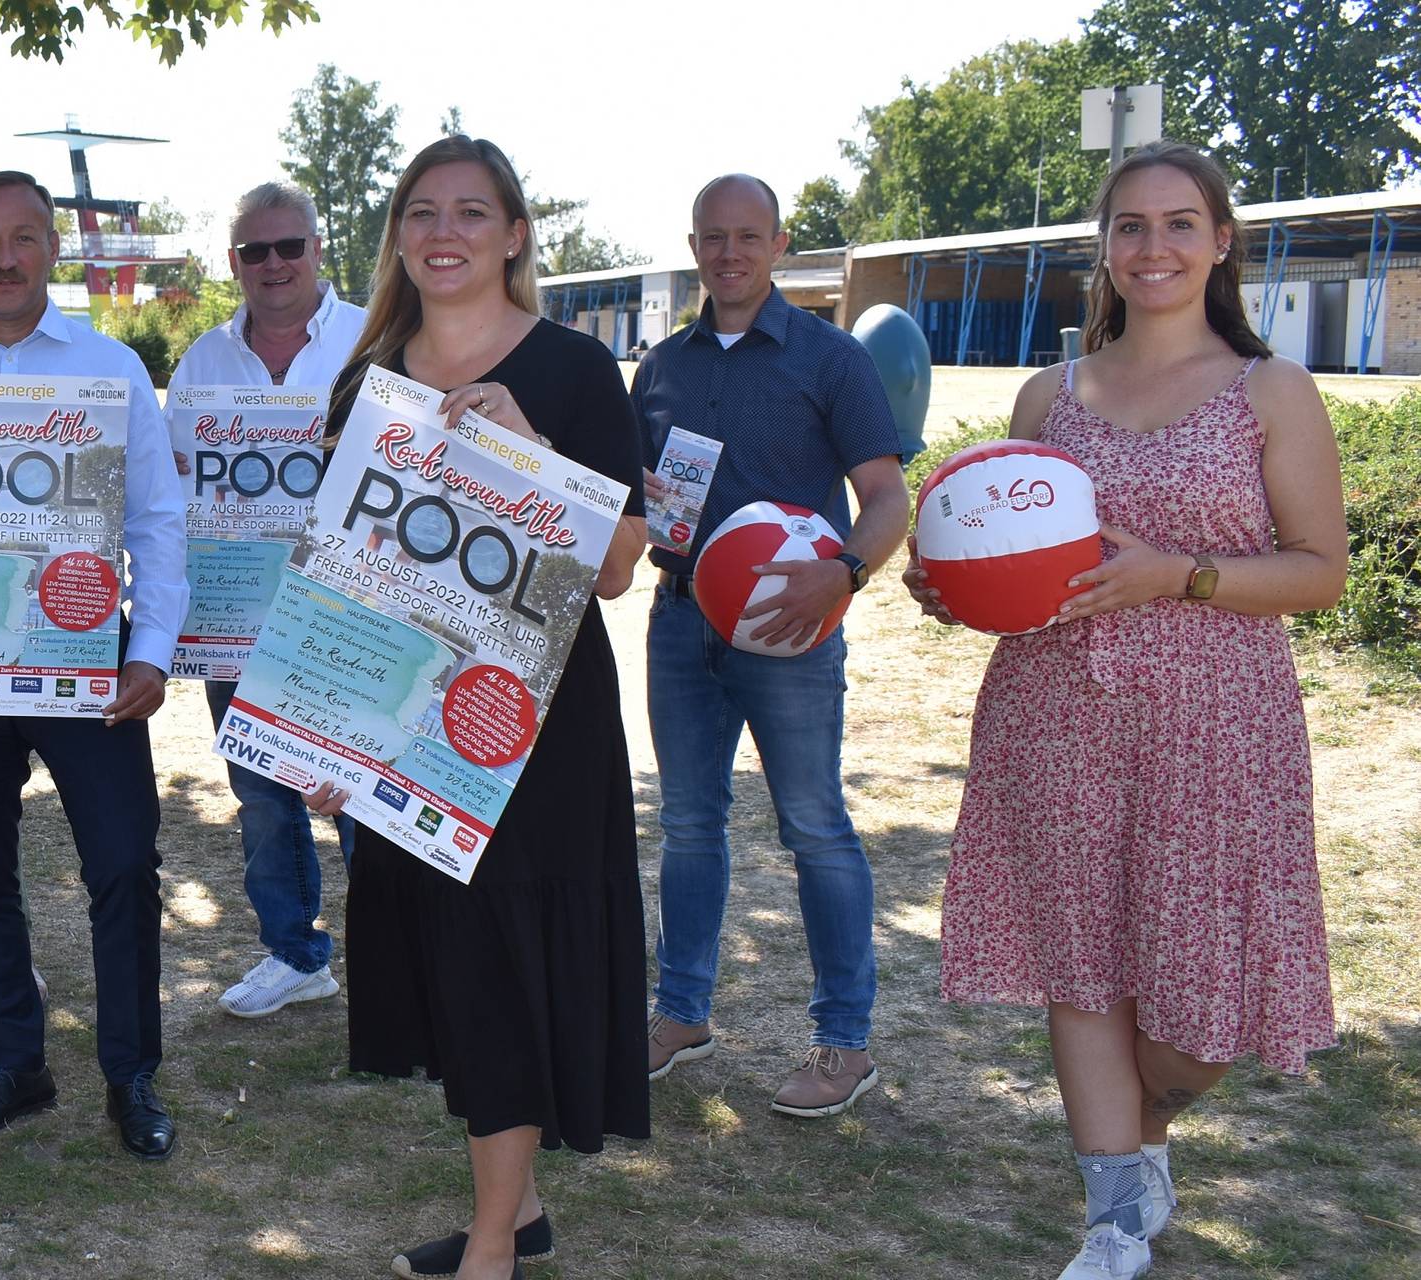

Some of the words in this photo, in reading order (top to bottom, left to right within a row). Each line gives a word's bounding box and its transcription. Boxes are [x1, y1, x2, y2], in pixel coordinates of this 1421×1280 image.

[96, 390, 126, 400] COLOGNE
[234, 393, 316, 408] westenergie
[386, 380, 429, 404] ELSDORF
[58, 409, 100, 444] the
[195, 413, 242, 445] Rock
[246, 413, 322, 442] around
[195, 451, 322, 498] POO
[373, 422, 447, 480] Rock
[442, 467, 538, 522] around
[527, 498, 576, 546] the
[661, 458, 706, 485] POOL
[187, 503, 204, 514] 27.
[210, 504, 258, 514] AUGUST
[264, 505, 294, 515] 2022
[564, 478, 579, 494] GIN
[584, 486, 620, 512] COLOGNE
[970, 500, 1008, 518] FREIBAD
[1010, 492, 1049, 505] ELSDORF
[1008, 478, 1054, 512] 60
[37, 514, 68, 526] 11-24
[76, 515, 102, 527] UHR
[186, 520, 228, 528] FREIBAD
[232, 520, 277, 529] ELSDORF
[20, 531, 72, 543] EINTRITT
[78, 534, 102, 544] FREI
[342, 466, 546, 627] POOL
[322, 534, 346, 555] 27.
[353, 549, 423, 585] AUGUST
[426, 580, 467, 609] 2022
[476, 605, 510, 633] 11-24
[515, 626, 546, 653] UHR
[314, 555, 372, 587] FREIBAD
[378, 582, 437, 616] ELSDORF
[448, 617, 508, 654] EINTRITT
[509, 650, 538, 672] FREI
[171, 663, 208, 675] RWE
[189, 650, 234, 658] Volksbank
[238, 650, 251, 659] Erf
[302, 636, 323, 654] Ben
[327, 647, 386, 683] Randerath
[285, 672, 321, 695] Marie
[324, 689, 352, 709] Reim
[453, 693, 466, 705] MIT
[456, 686, 490, 712] LIVE-MUSIK
[484, 670, 498, 684] Ab
[497, 678, 507, 689] 12
[505, 681, 523, 701] Uhr
[274, 701, 288, 711] A
[292, 706, 328, 733] Tribute
[331, 724, 342, 737] to
[346, 732, 383, 753] ABBA
[453, 724, 497, 757] COCKTAIL-BAR
[468, 724, 511, 756] COLOGNE-BAR
[219, 734, 275, 770] RWE
[252, 726, 317, 763] Volksbank
[318, 756, 342, 775] Erft
[343, 768, 362, 784] eG
[453, 735, 487, 761] FOOD-AREA
[274, 718, 325, 745] VERANSTALTER:
[325, 741, 344, 754] Stadt
[343, 749, 365, 764] Elsdorf
[369, 761, 383, 772] Zum
[383, 768, 406, 785] Freibad
[411, 785, 431, 800] 50189
[430, 796, 452, 812] Elsdorf
[379, 783, 404, 803] ZIPPEL
[456, 829, 475, 845] REWE
